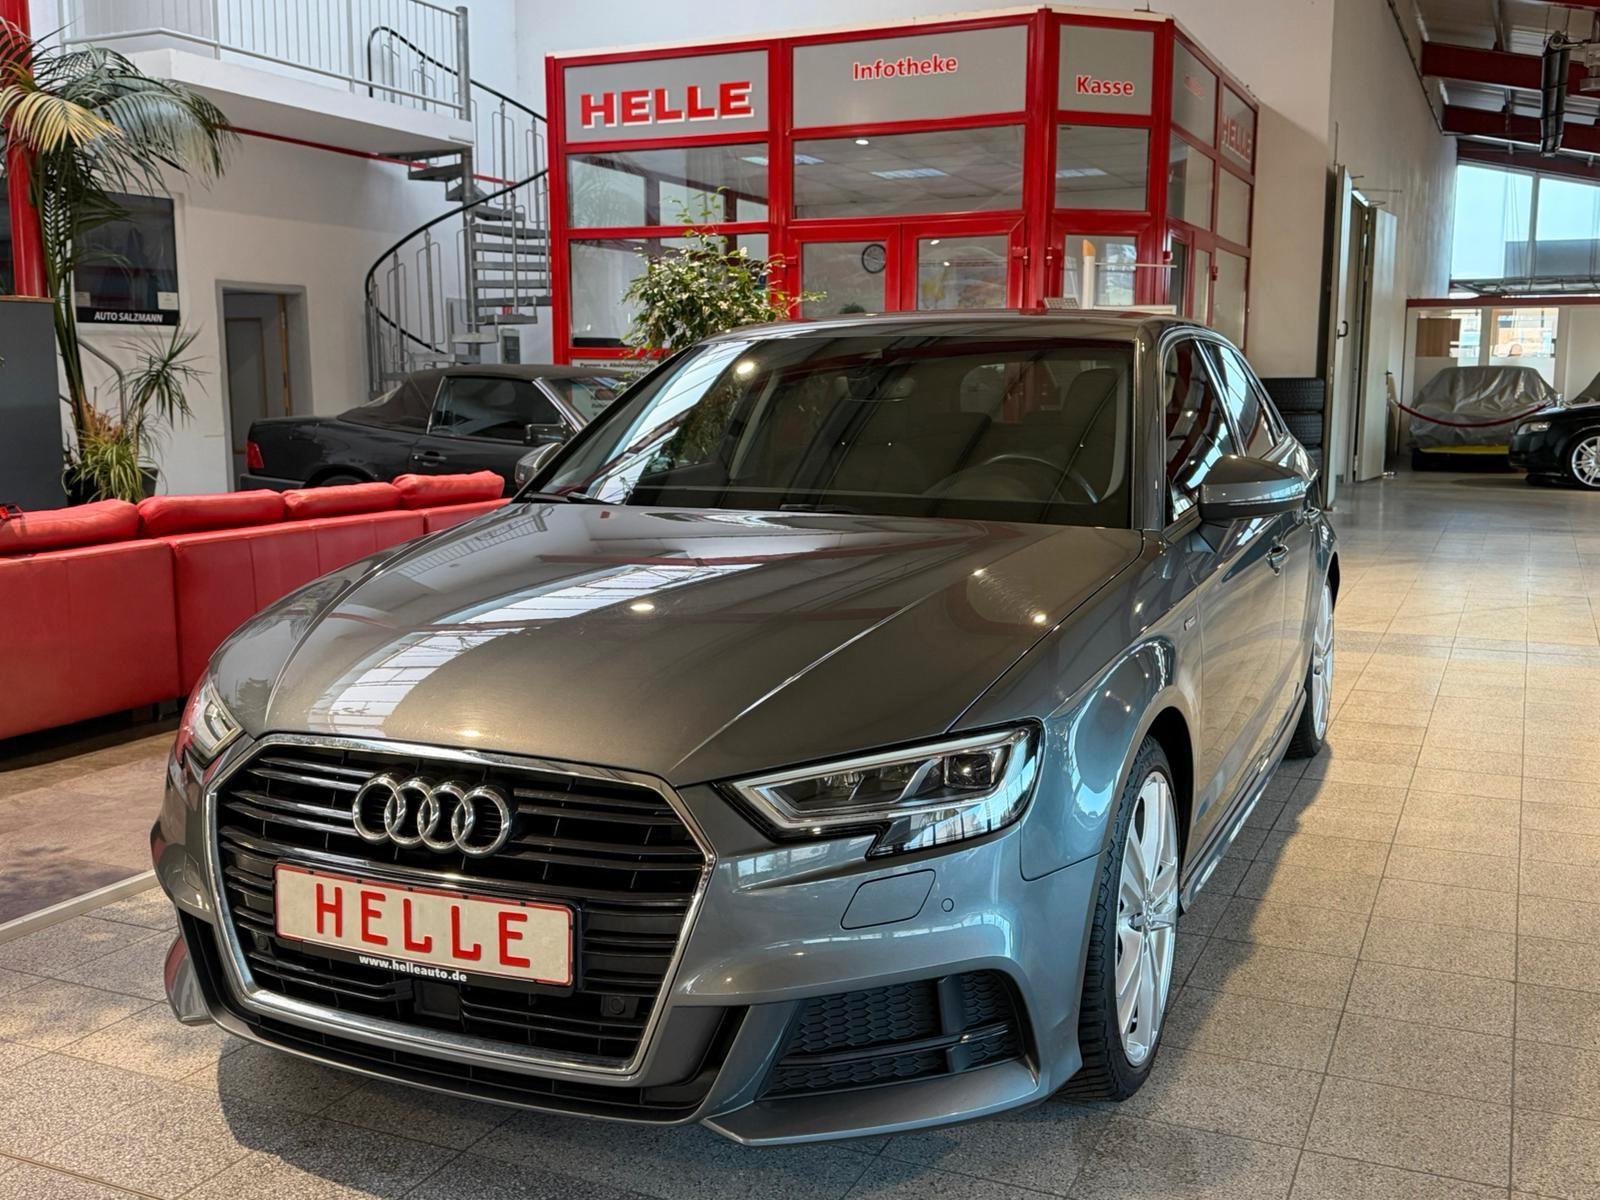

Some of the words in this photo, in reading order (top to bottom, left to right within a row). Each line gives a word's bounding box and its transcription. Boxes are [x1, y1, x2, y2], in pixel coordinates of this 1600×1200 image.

[853, 53, 958, 81] Infotheke
[1075, 74, 1135, 97] Kasse
[580, 81, 754, 129] HELLE
[94, 311, 118, 321] AUTO
[118, 312, 164, 323] SALZMANN
[315, 883, 531, 968] HELLE
[358, 954, 468, 982] www.helleauto.de
